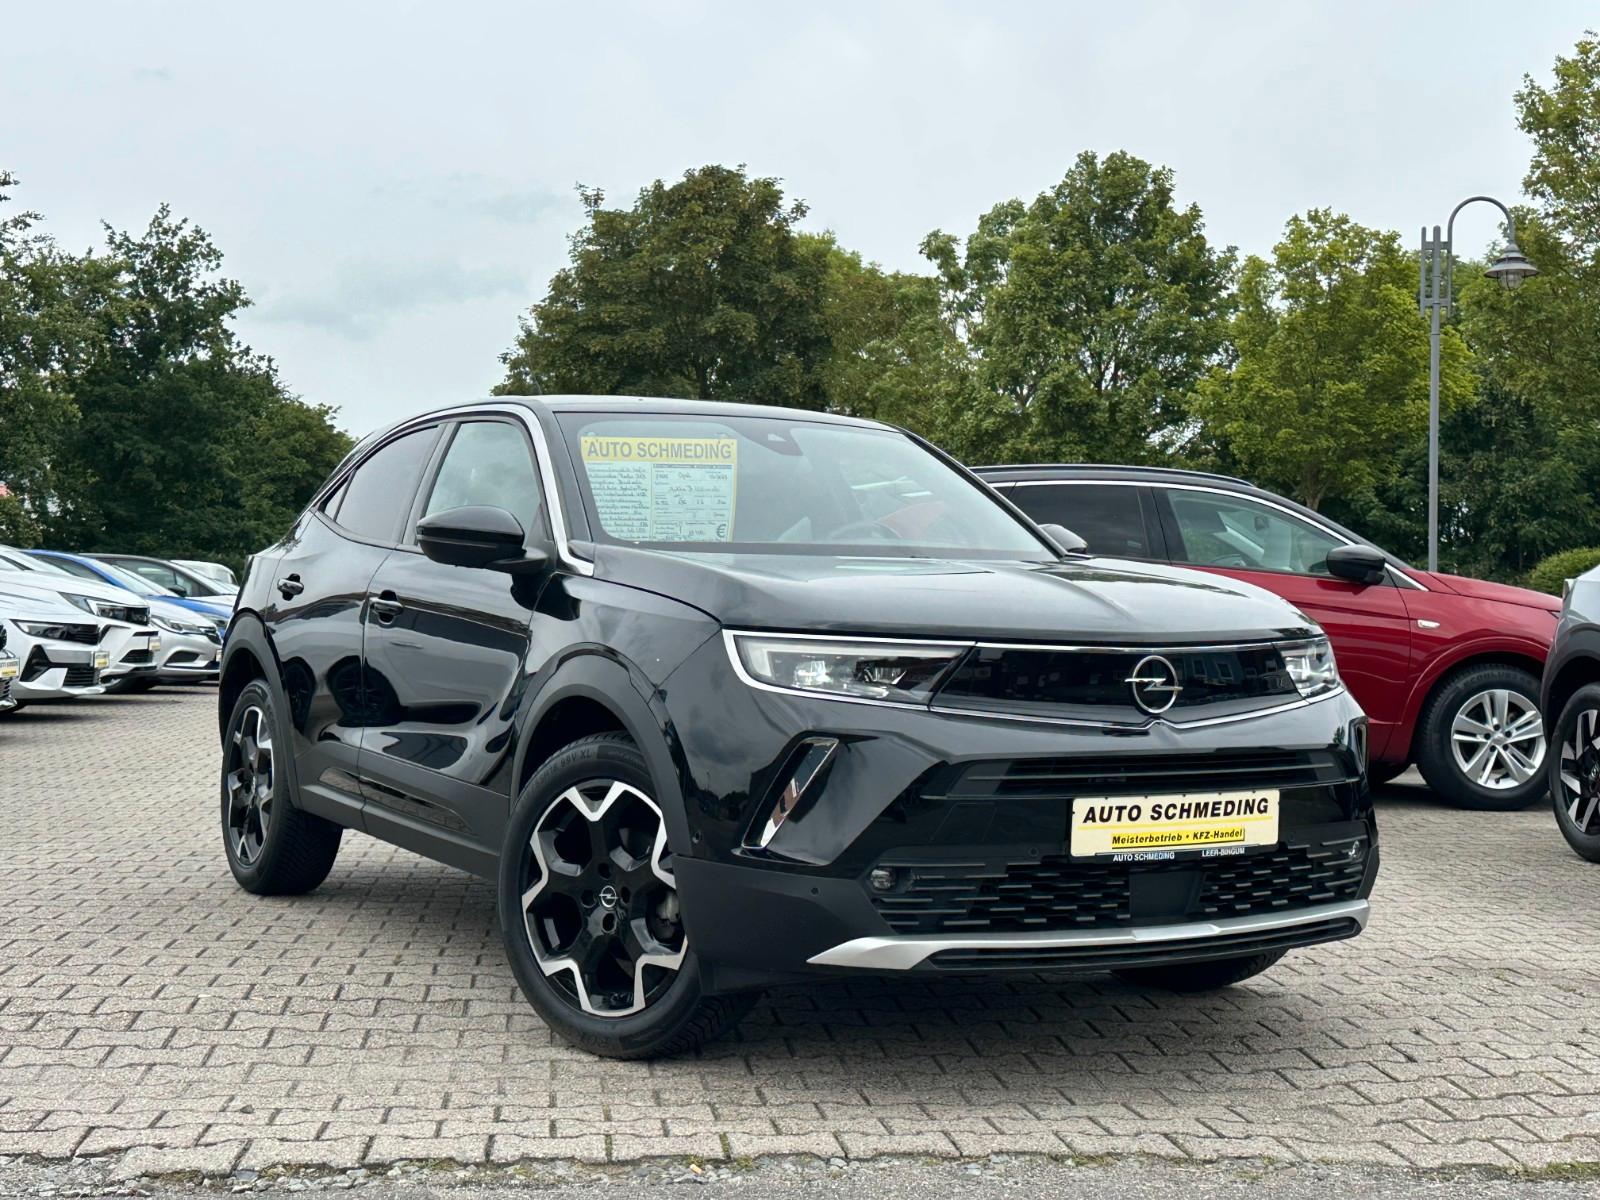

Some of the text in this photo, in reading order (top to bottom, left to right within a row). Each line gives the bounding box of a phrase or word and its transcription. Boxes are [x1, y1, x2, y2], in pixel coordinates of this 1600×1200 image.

[587, 441, 732, 459] AUTO SCHMEDING
[1083, 797, 1269, 823] AUTO SCHMEDING
[1111, 829, 1243, 845] Meisterbetrieb KFZ-Handel
[1112, 852, 1133, 862] AUTO
[1134, 851, 1176, 861] SCHMEDING
